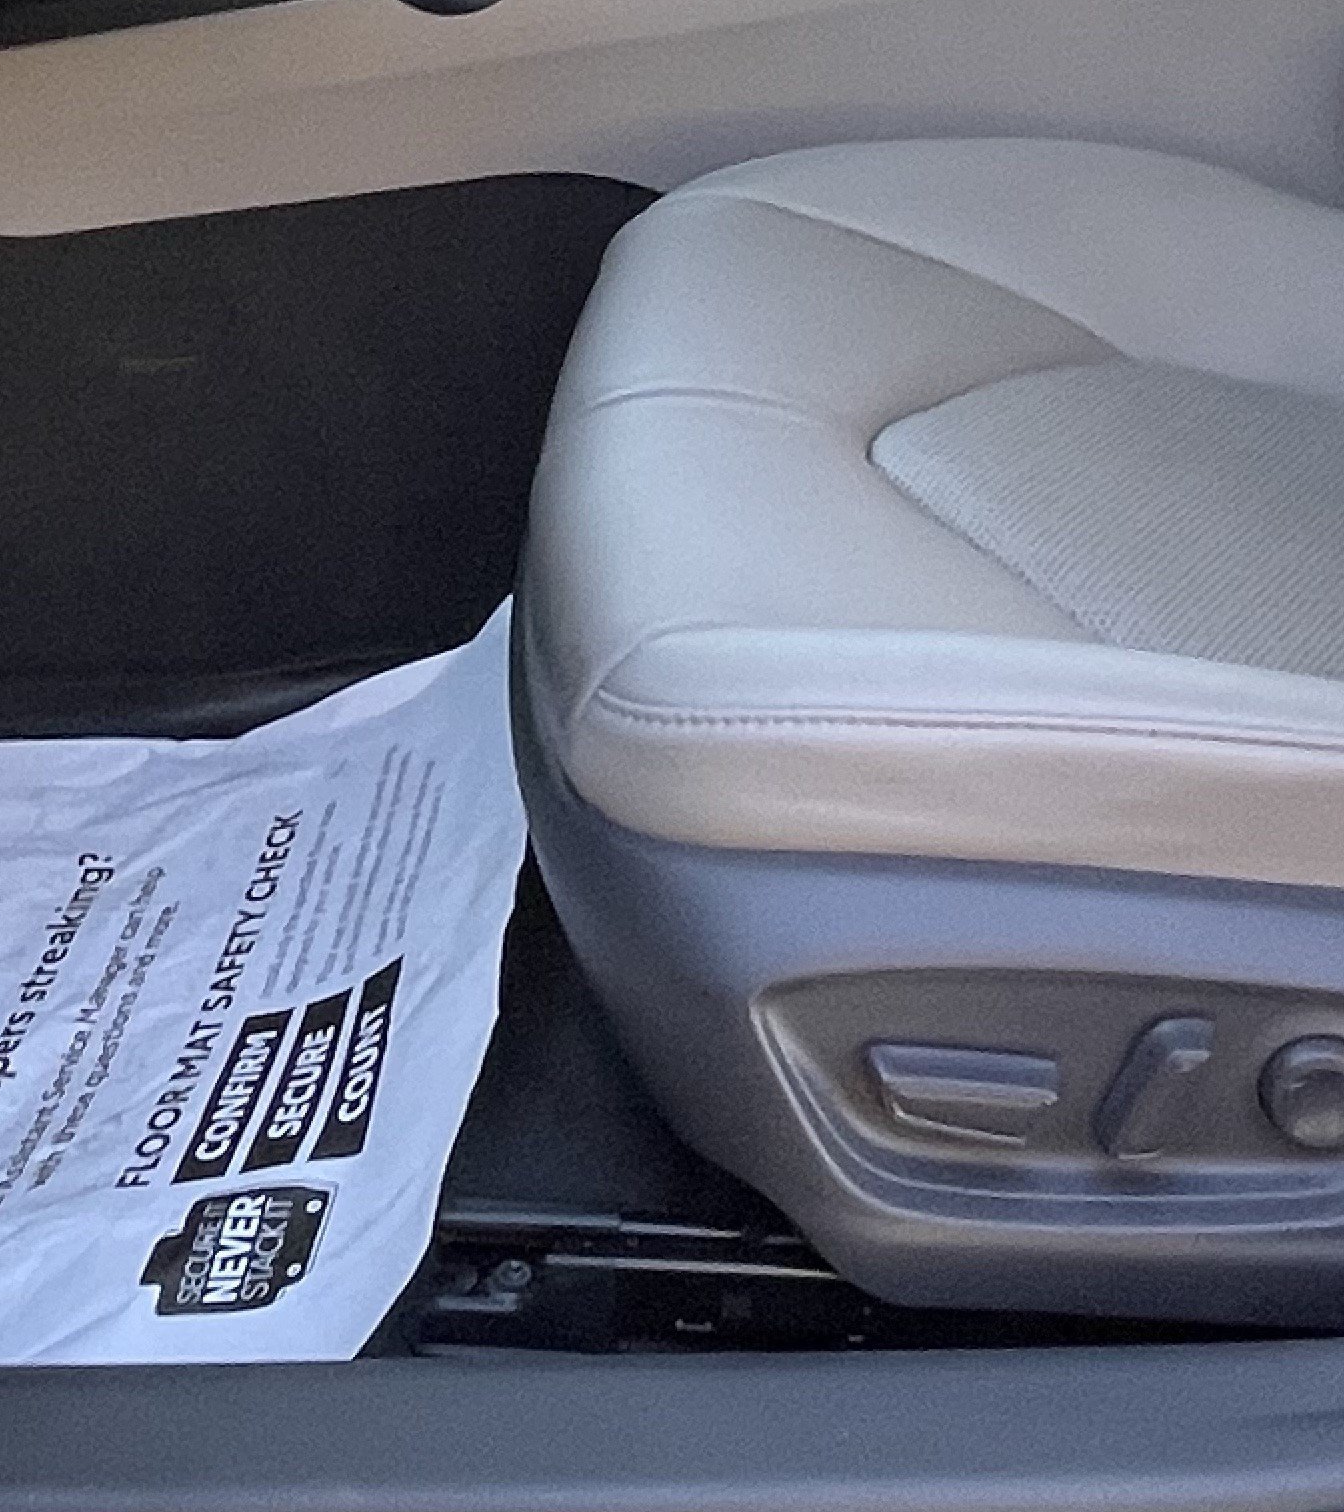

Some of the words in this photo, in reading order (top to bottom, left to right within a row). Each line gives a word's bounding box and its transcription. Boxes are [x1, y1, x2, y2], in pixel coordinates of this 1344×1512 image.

[21, 852, 115, 1003] streaking?
[116, 1085, 192, 1188] FLOOR
[169, 1020, 223, 1083] MAT
[202, 910, 266, 1010] SAFETY
[245, 809, 303, 902] CHECK
[195, 1030, 278, 1162] CONFIRM
[269, 1025, 335, 1139] SECURE
[338, 1004, 387, 1123] COUNT
[176, 1218, 222, 1303] SECURE
[203, 1194, 266, 1304] NEVER
[240, 1220, 288, 1301] STACK
[264, 1196, 294, 1219] IT
